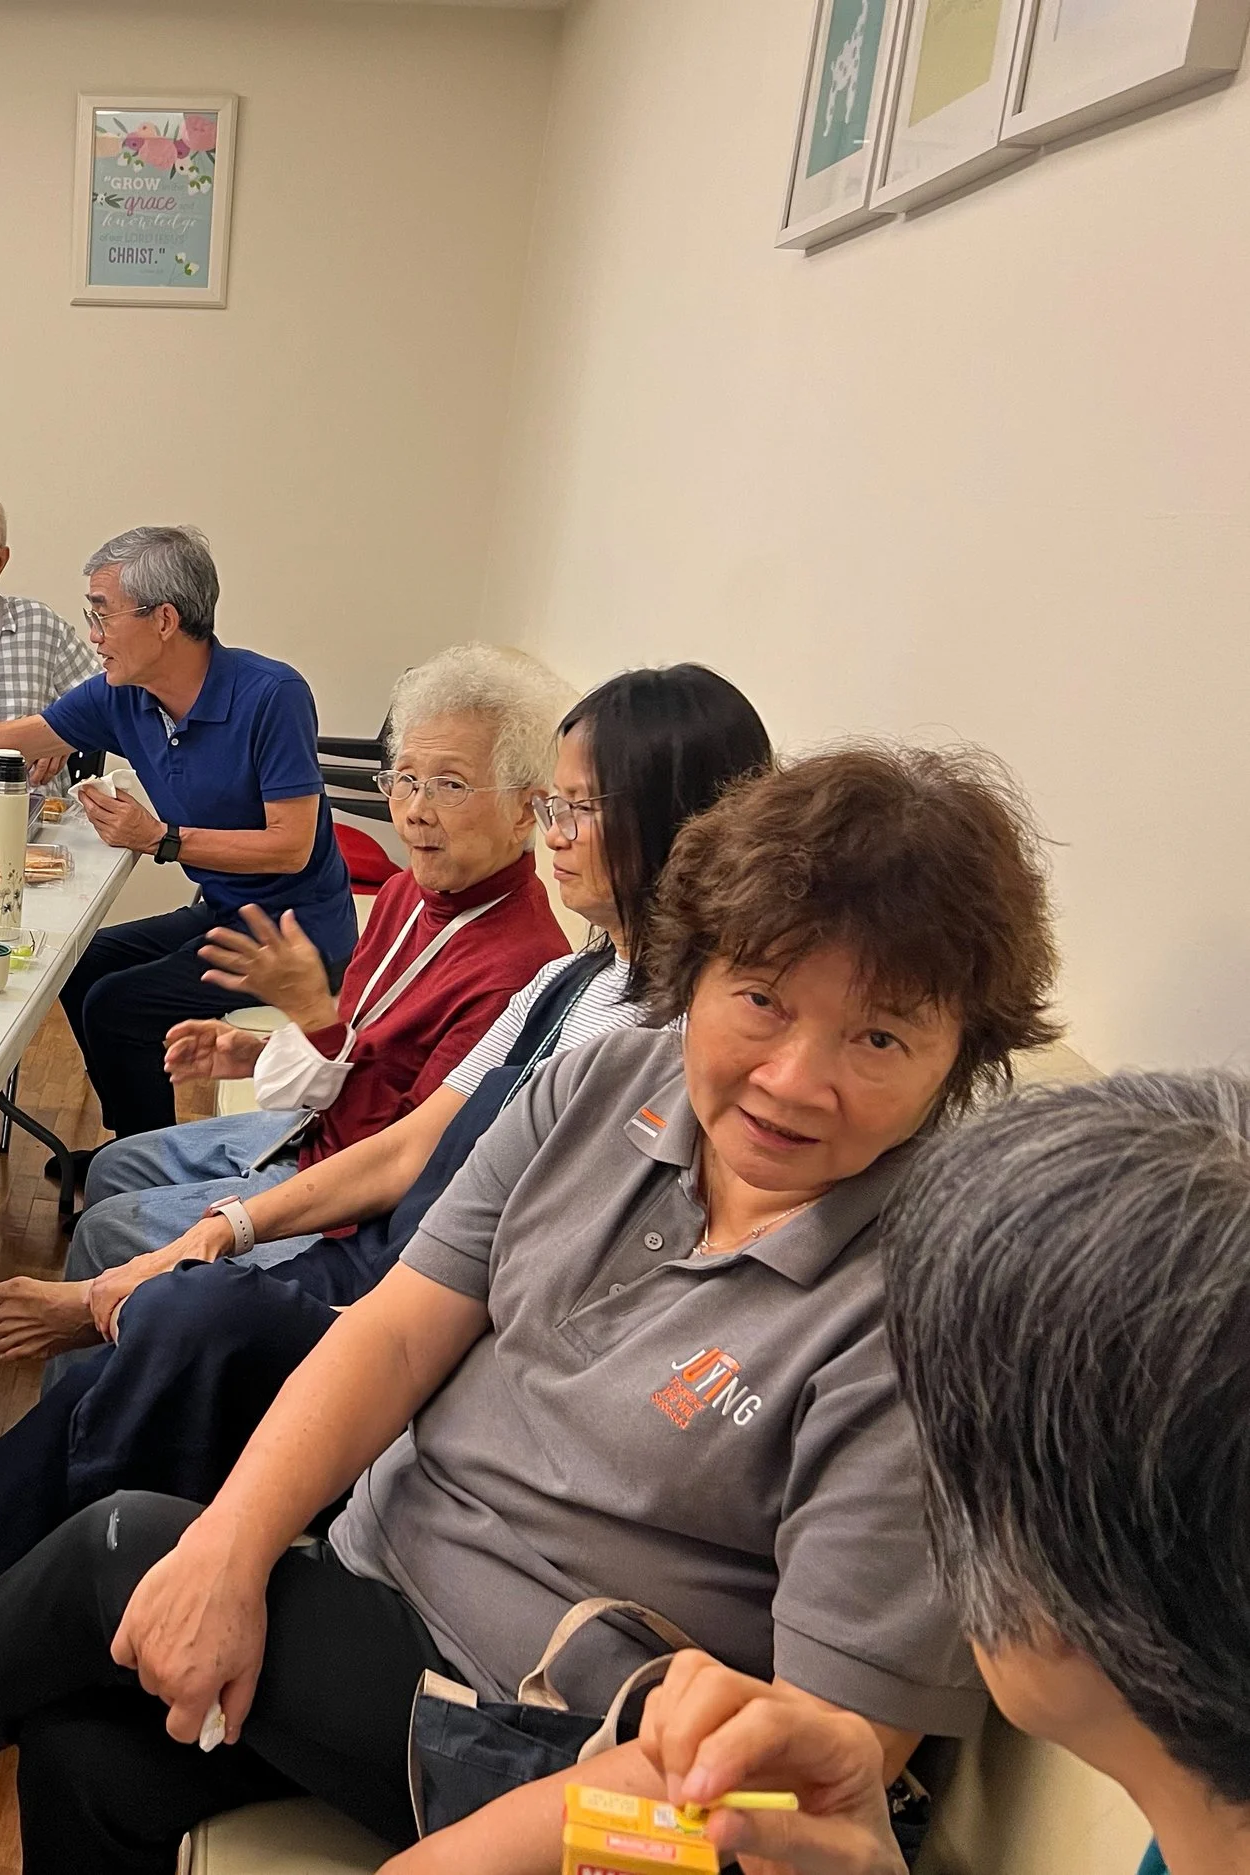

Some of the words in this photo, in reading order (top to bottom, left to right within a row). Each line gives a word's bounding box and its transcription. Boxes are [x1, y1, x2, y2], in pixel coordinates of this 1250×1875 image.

[124, 195, 177, 216] grace
[101, 212, 197, 234] knowledge
[108, 247, 166, 265] CHRIST."
[671, 1347, 762, 1426] JUYING
